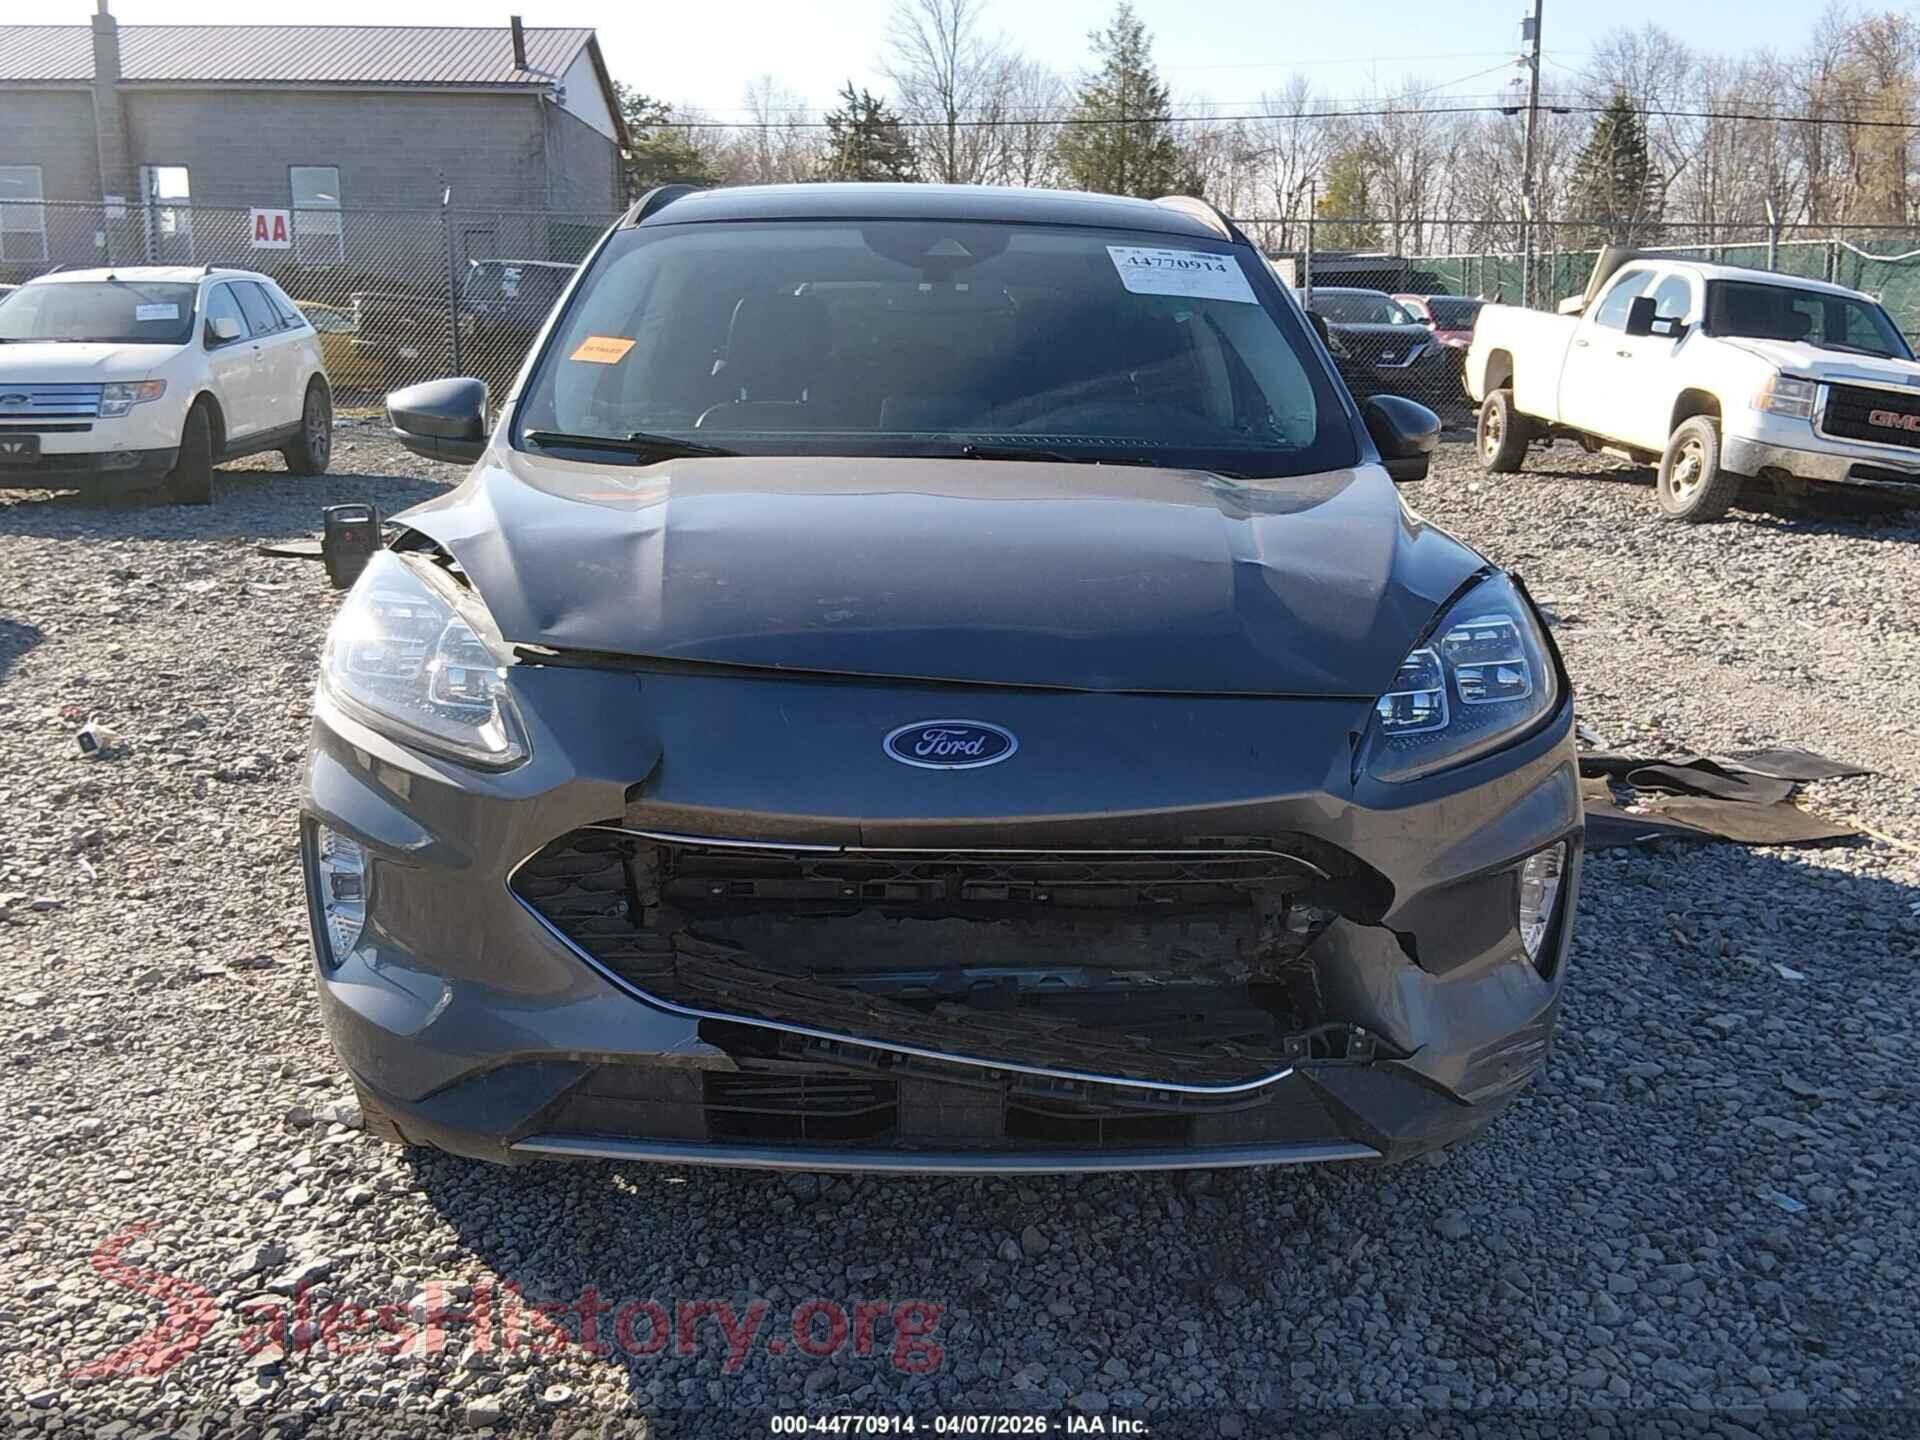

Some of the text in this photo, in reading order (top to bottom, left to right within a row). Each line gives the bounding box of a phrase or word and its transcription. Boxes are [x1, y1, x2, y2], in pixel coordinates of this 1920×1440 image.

[255, 214, 288, 241] AA
[1126, 256, 1228, 273] 44770914
[915, 728, 985, 755] Ford
